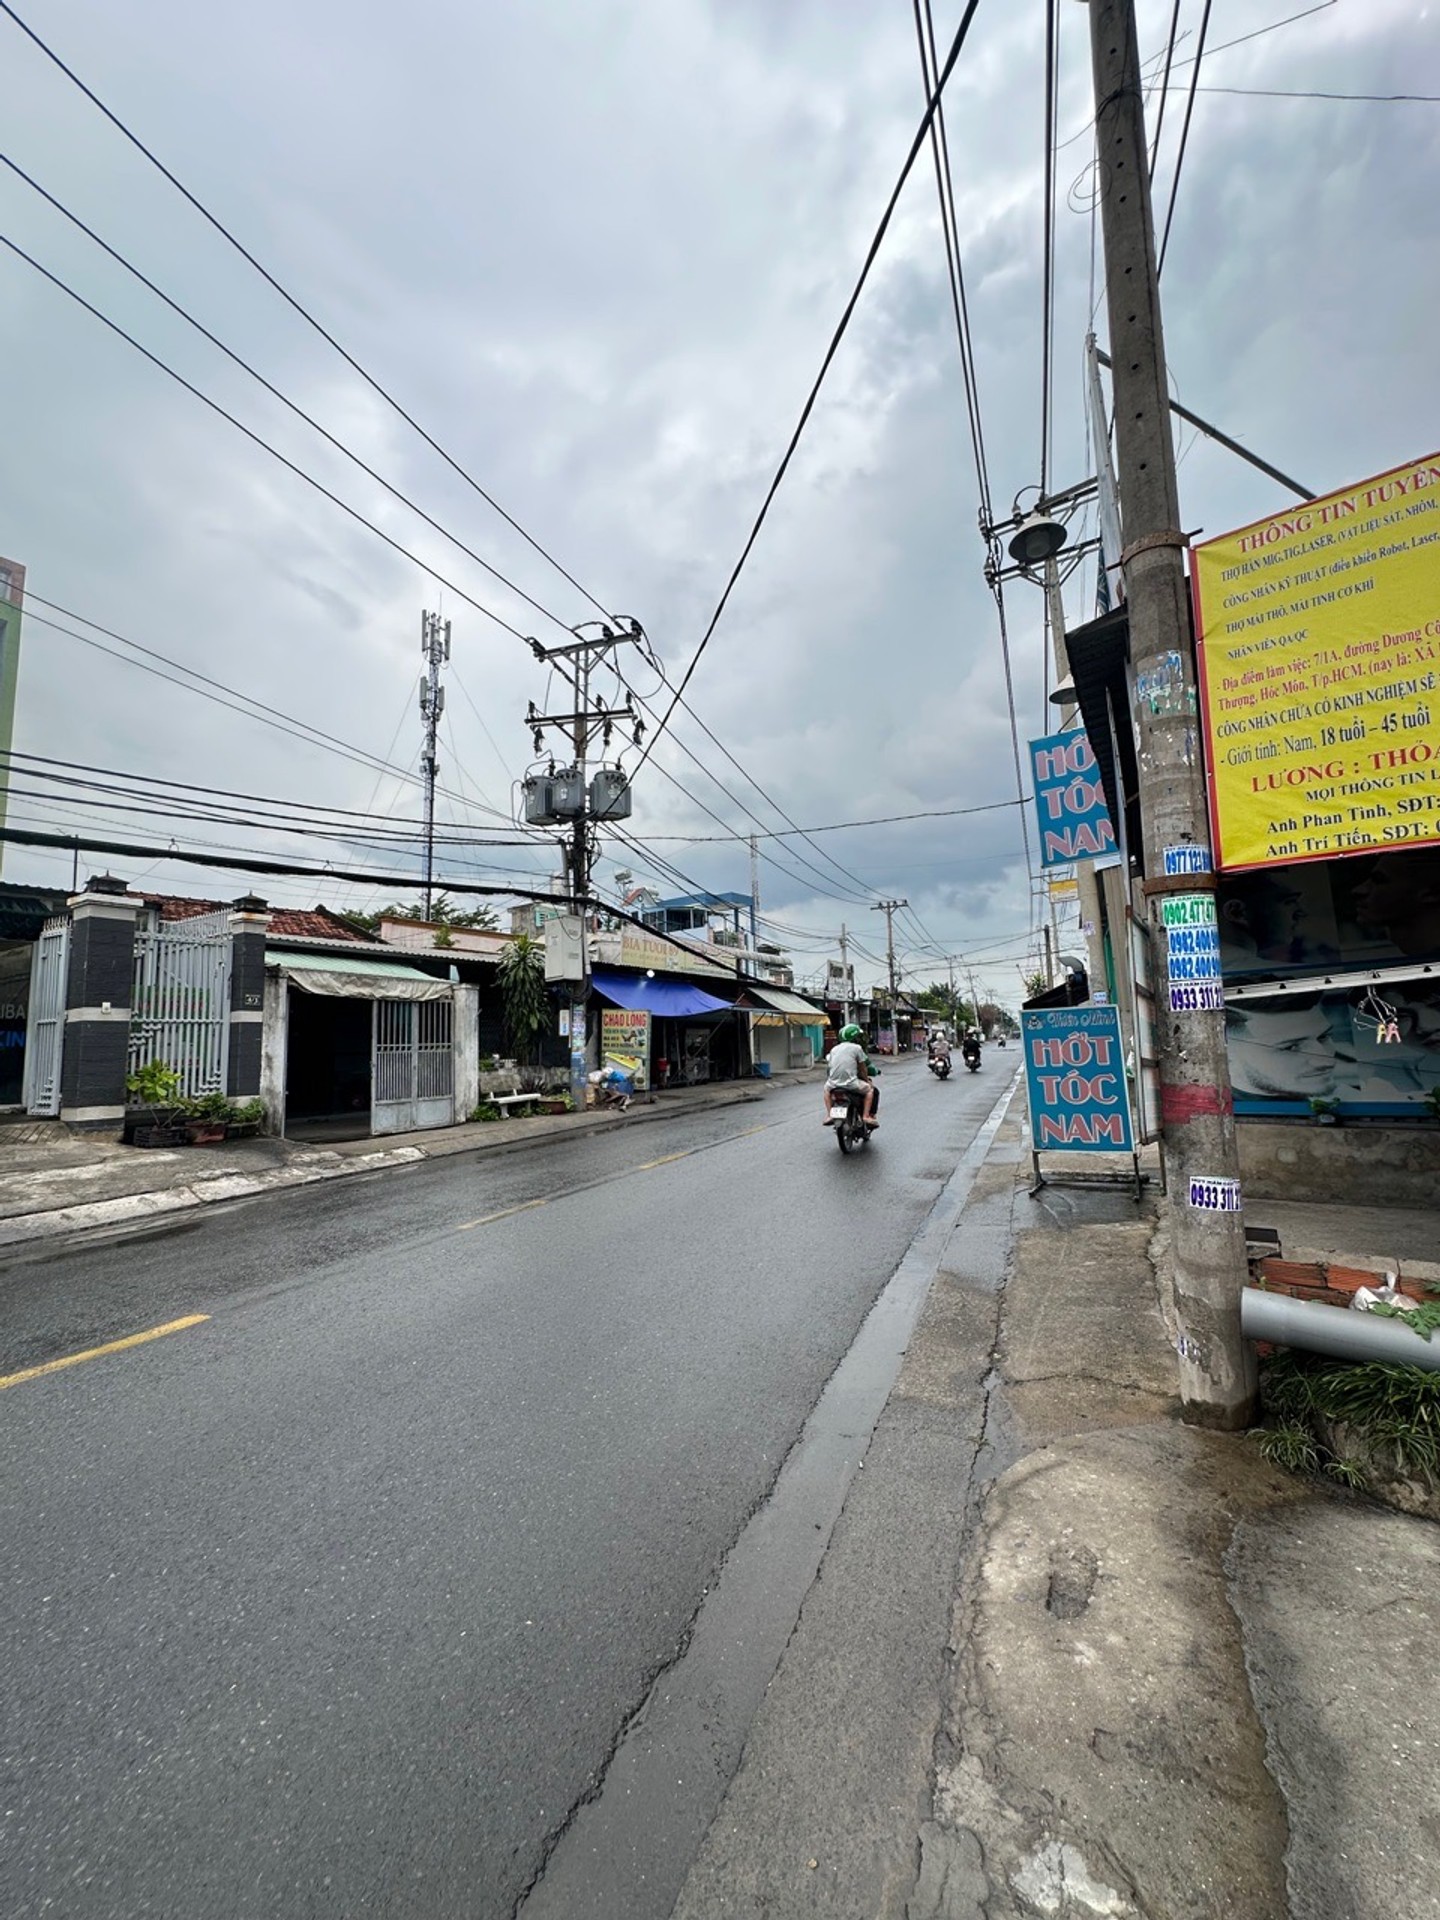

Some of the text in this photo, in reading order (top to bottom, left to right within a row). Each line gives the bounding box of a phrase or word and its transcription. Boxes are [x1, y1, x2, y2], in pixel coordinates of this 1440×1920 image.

[1237, 514, 1312, 553] THÔNG
[1318, 496, 1357, 524] TIN
[1221, 568, 1240, 582] THỢ
[1223, 592, 1249, 609] CÔNG
[1251, 582, 1277, 598] NHÂN
[1294, 565, 1327, 586] THUẬT
[1353, 548, 1377, 567] khiển
[1379, 541, 1409, 558] Robot,
[1226, 620, 1245, 634] THỢ
[1337, 584, 1353, 599] CƠ
[1354, 576, 1374, 595] KHÍ
[1222, 676, 1239, 692] Địa
[1241, 667, 1264, 685] điểm
[1266, 666, 1285, 679] làm
[1287, 657, 1311, 675] việc:
[1344, 640, 1380, 658] đường
[1382, 629, 1422, 648] Dương
[1228, 644, 1253, 660] NHÂN
[1255, 637, 1277, 652] VIÊN
[1218, 693, 1258, 711] Thượng,
[1260, 684, 1279, 701] Hóc
[1369, 658, 1392, 675] (nay
[1396, 651, 1412, 667] là:
[1414, 641, 1435, 662] XÃ
[1217, 671, 1436, 739] CÔNG NHÂN CHƯA CÓ KINH NGHIỆM SẼ
[1227, 744, 1252, 766] Giới
[1255, 739, 1281, 760] tính:
[1283, 735, 1317, 754] Nam,
[1321, 726, 1336, 747] 18
[1339, 715, 1366, 743] tuổi
[1381, 712, 1398, 733] 45
[1401, 701, 1431, 730] tuổi
[1035, 734, 1097, 781] HỚ
[1252, 760, 1344, 793] LƯƠNG
[1306, 788, 1335, 802] MỌI
[1339, 777, 1394, 796] THÔNG
[1398, 770, 1425, 786] TIN
[1267, 818, 1297, 834] Anh
[1303, 812, 1342, 829] Phan
[1397, 794, 1440, 814] SĐT:
[1266, 841, 1298, 858] Anh
[1302, 835, 1328, 852] Trí
[1333, 826, 1378, 848] Tiến,
[1382, 822, 1429, 841] SĐT:
[1165, 850, 1186, 874] 0977
[623, 935, 640, 951] BIA
[1170, 930, 1195, 954] 0982
[1170, 956, 1194, 979] 0982
[1171, 987, 1197, 1010] 0933
[1199, 986, 1214, 1009] 311
[1037, 1069, 1119, 1105] TÓC
[1040, 1113, 1125, 1144] NAM
[1191, 1184, 1218, 1209] 0933
[1220, 1187, 1234, 1210] 311
